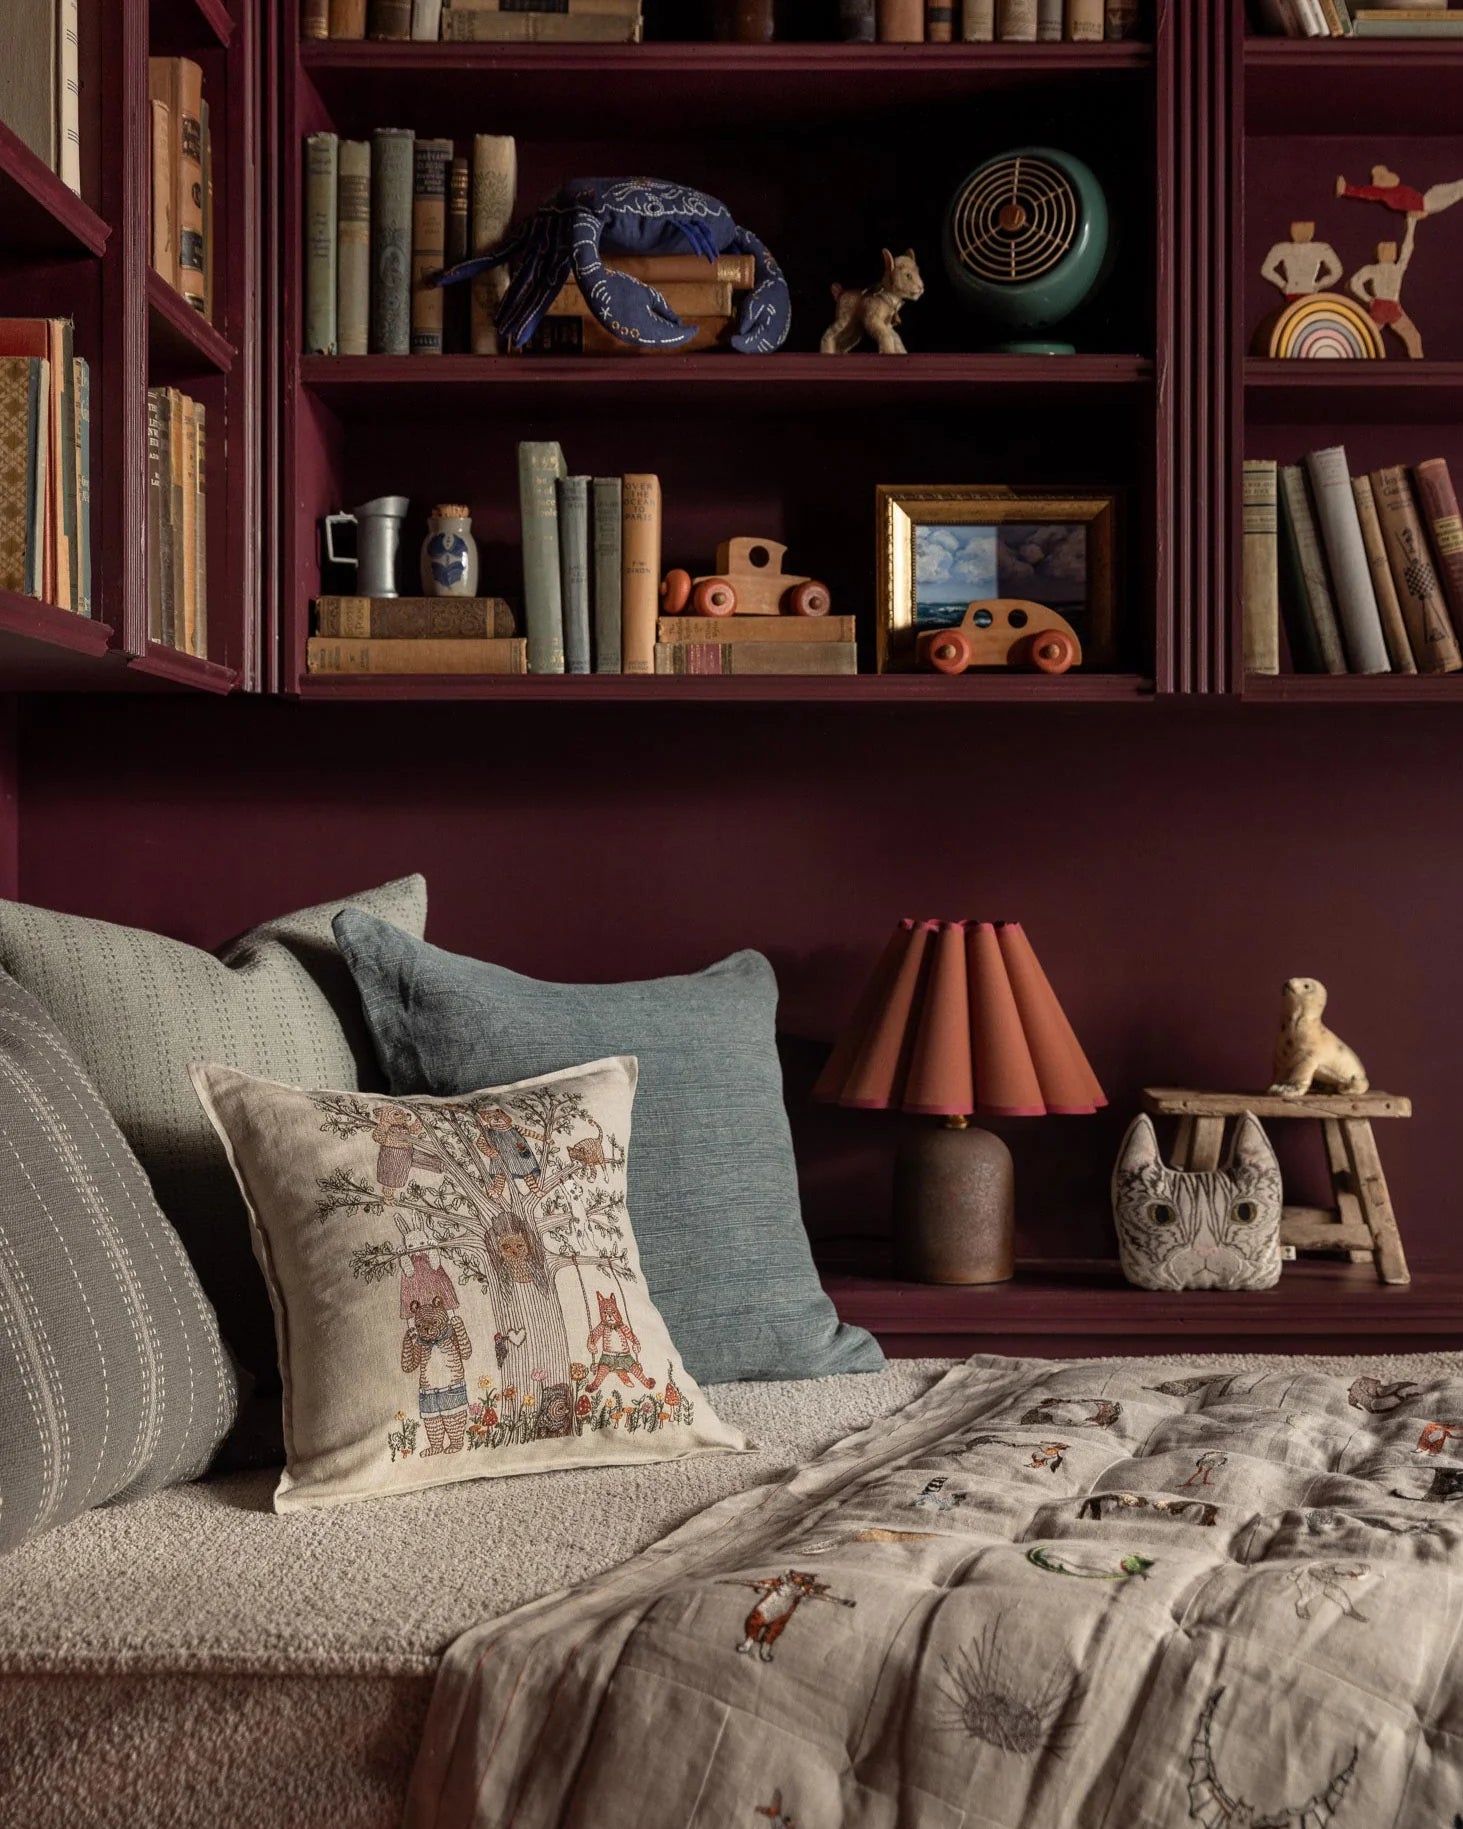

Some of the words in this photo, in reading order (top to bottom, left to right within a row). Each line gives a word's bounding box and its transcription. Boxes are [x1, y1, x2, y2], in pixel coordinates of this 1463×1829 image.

[624, 482, 653, 491] OVER
[623, 498, 656, 506] OCEAN
[623, 513, 653, 521] PARIS
